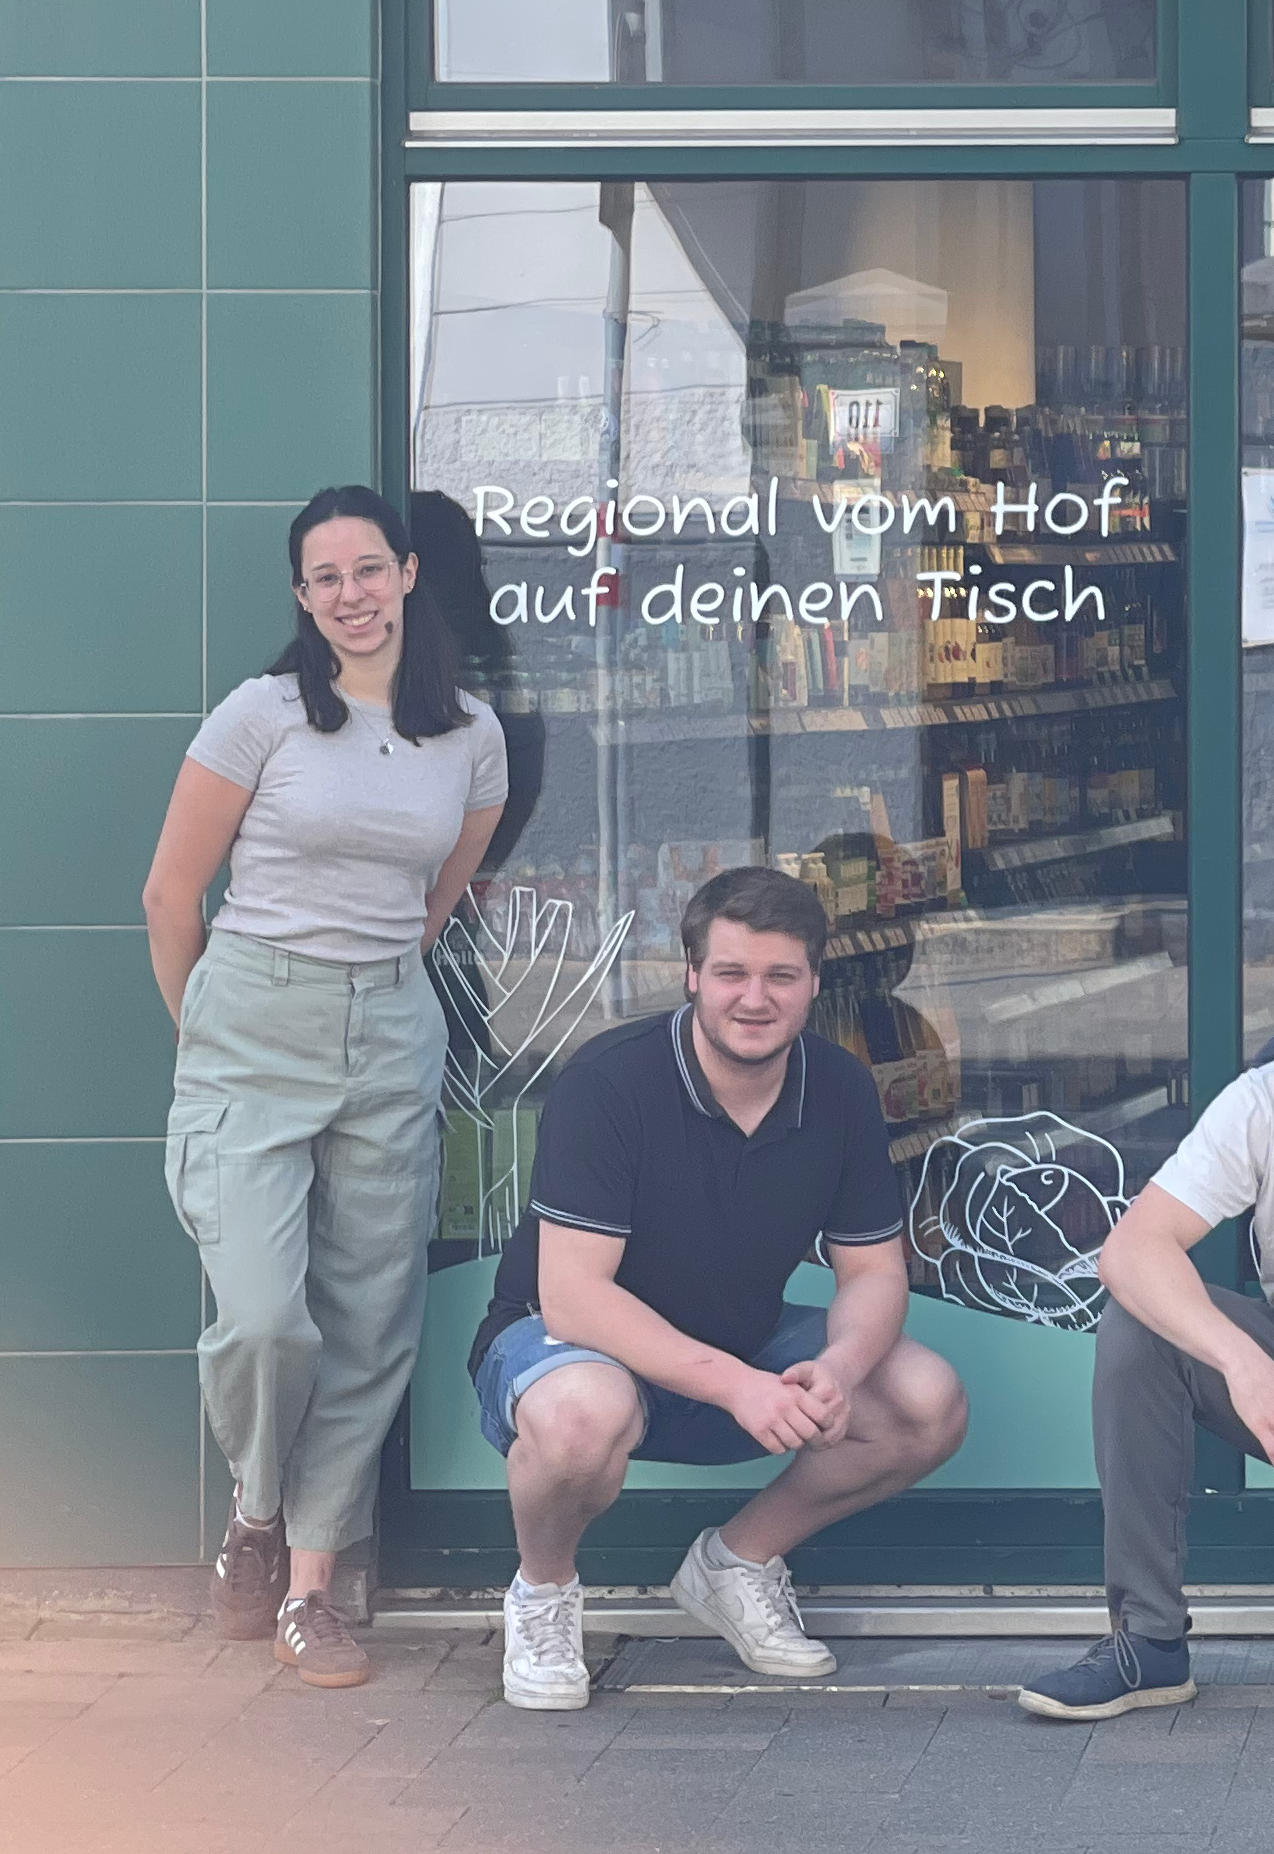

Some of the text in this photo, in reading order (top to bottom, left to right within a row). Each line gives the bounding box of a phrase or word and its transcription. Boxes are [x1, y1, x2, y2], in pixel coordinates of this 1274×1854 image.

[472, 476, 779, 557] Regional
[812, 487, 956, 536] vom
[990, 477, 1130, 537] Hof
[490, 564, 1106, 627] auf deinen Tisch
